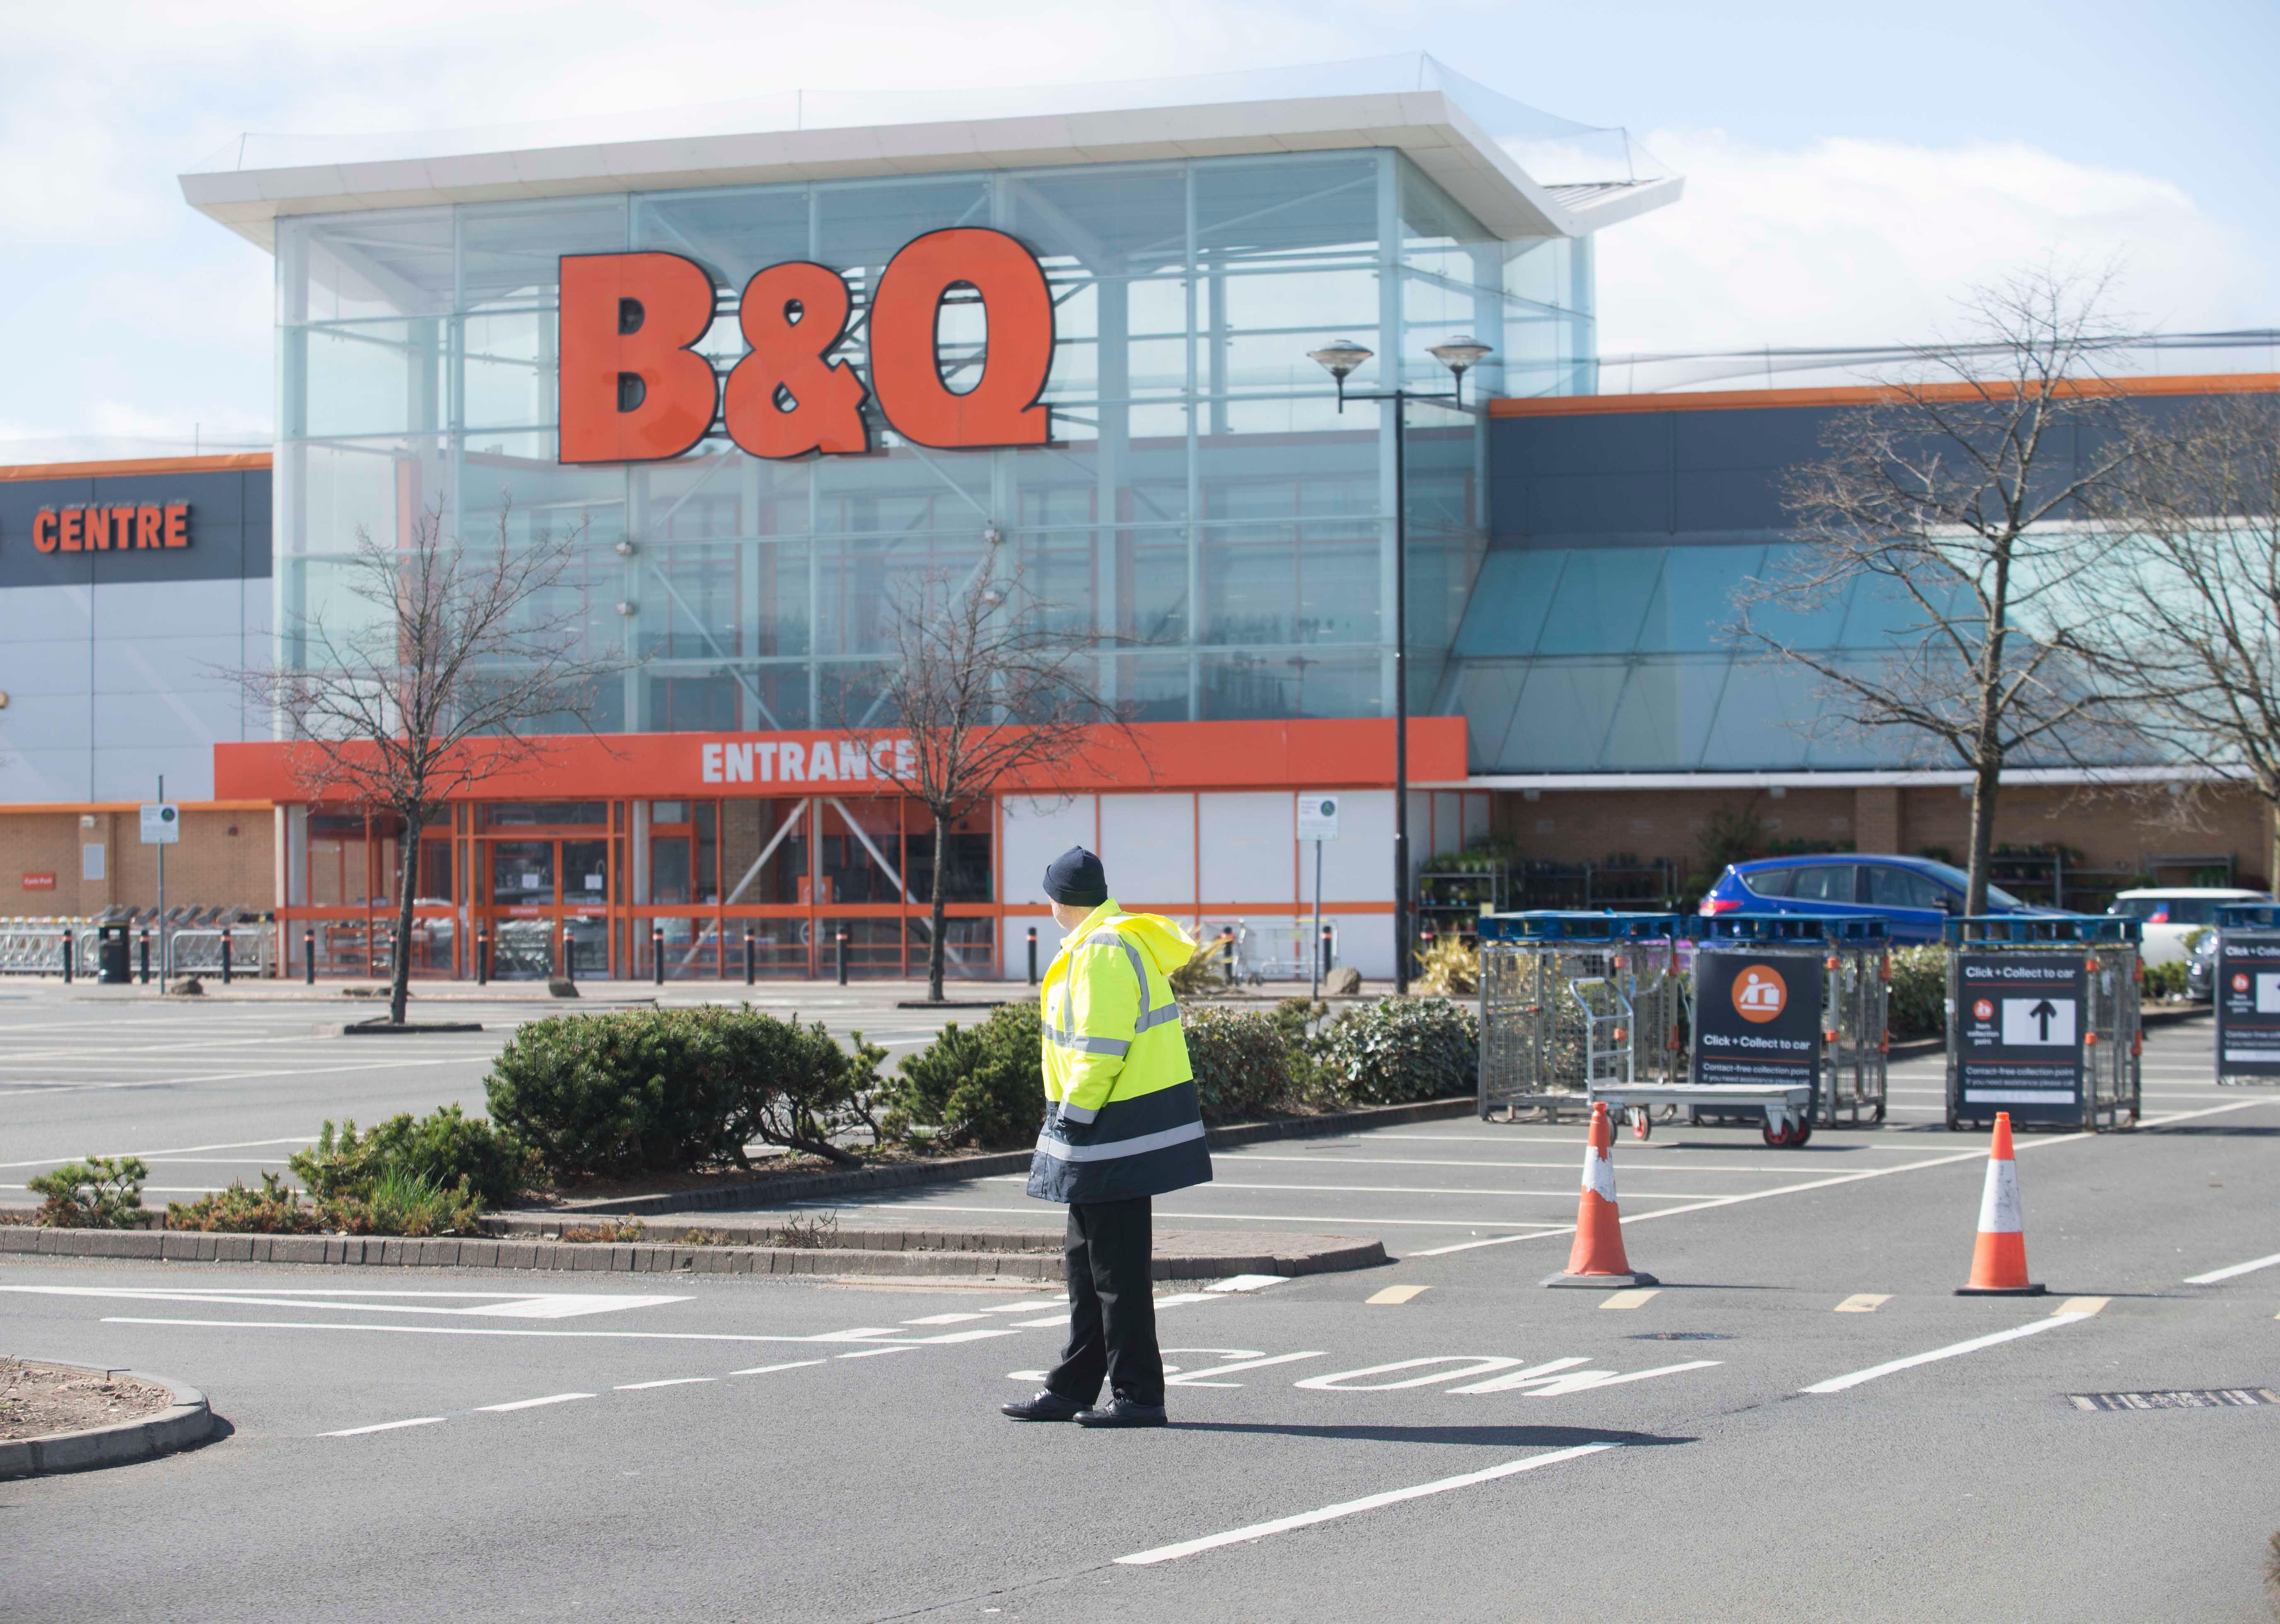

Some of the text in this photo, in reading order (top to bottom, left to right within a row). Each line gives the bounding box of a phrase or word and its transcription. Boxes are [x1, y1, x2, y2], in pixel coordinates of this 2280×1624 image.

[558, 226, 1056, 464] B&Q
[33, 505, 187, 553] CENTRE
[702, 739, 917, 783] ENTRANCE
[1965, 965, 1994, 978] Click
[2003, 966, 2043, 979] Collect
[2043, 968, 2055, 978] to
[2057, 968, 2075, 979] car
[1703, 1034, 1731, 1046] Click
[1740, 1036, 1778, 1049] Collect
[1780, 1040, 1792, 1049] to
[1793, 1040, 1811, 1050] car
[1703, 1063, 1810, 1076] Contact-free collection point
[1966, 1067, 2074, 1077] Contact-free collection point
